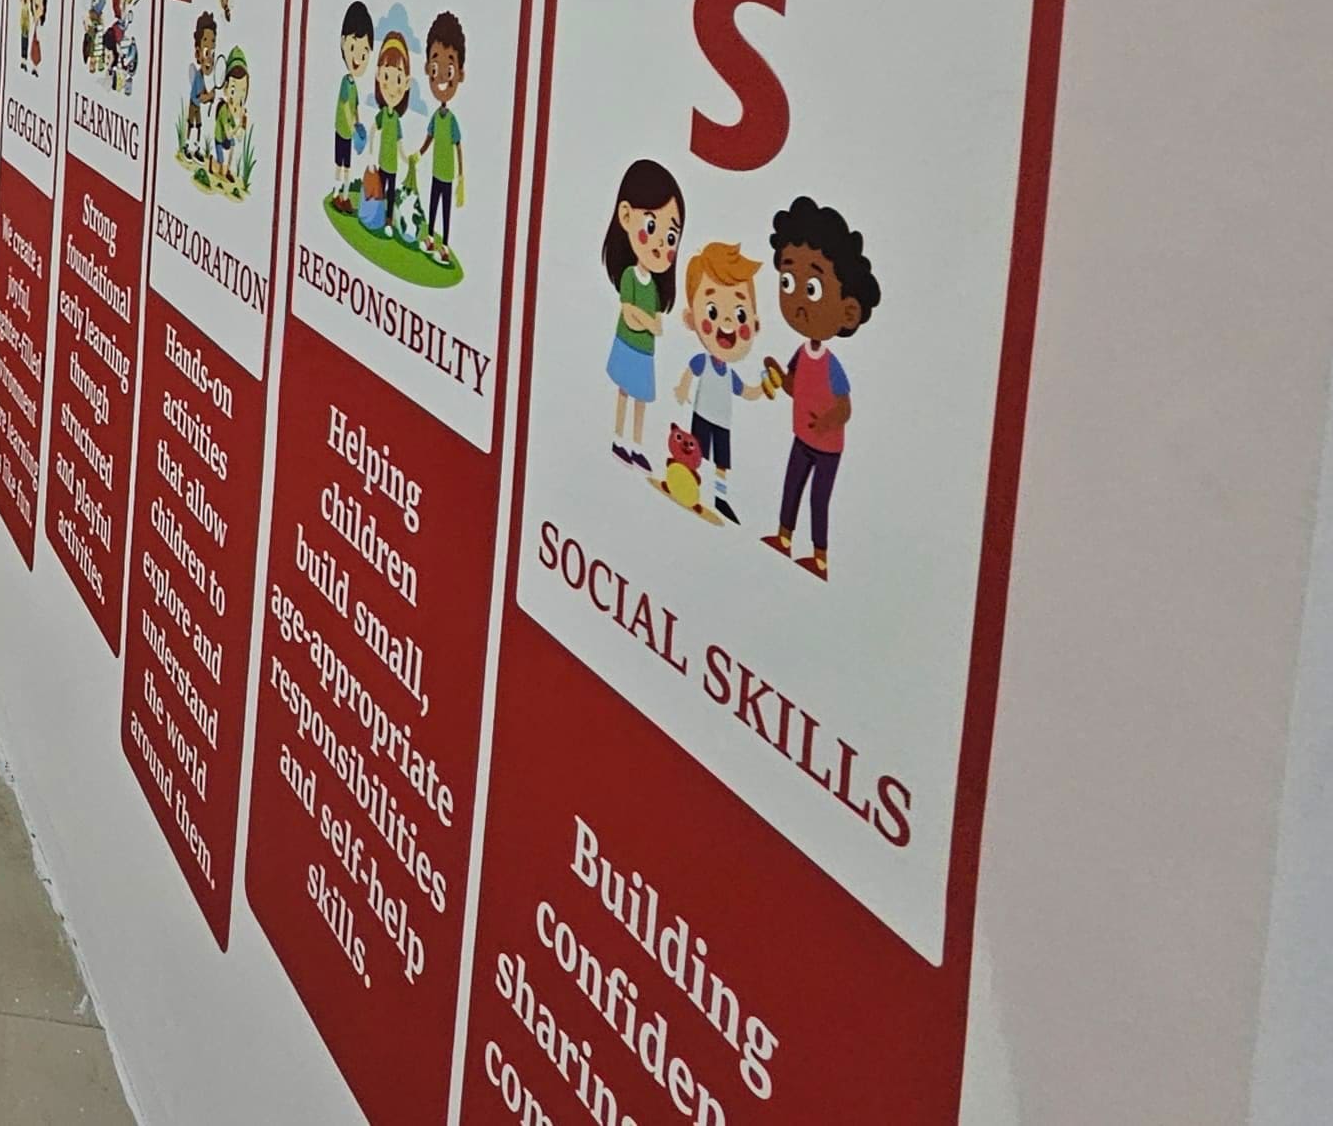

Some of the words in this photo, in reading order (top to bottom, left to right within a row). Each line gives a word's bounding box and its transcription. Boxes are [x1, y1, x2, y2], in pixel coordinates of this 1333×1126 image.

[6, 97, 53, 159] GIGGLES
[74, 92, 139, 161] LEARNING
[13, 232, 36, 272] create
[37, 255, 42, 279] a
[66, 234, 132, 324] foundational
[83, 194, 118, 257] Strong
[156, 205, 269, 316] EXPLORATION
[59, 290, 84, 341] early
[84, 307, 131, 394] learning
[165, 323, 233, 419] Hands-on
[298, 244, 492, 397] RESPONSIBILTY
[70, 351, 109, 425] through
[162, 390, 229, 482] activities
[2, 453, 16, 498] like
[7, 411, 39, 492] learning
[56, 452, 75, 495] and
[75, 478, 112, 553] playful
[61, 403, 113, 491] structured
[158, 439, 184, 498] that
[186, 478, 228, 548] allow
[327, 404, 423, 534] Helping
[57, 510, 105, 605] activities.
[151, 496, 206, 595] children
[209, 570, 227, 617] to
[321, 482, 418, 608] children
[142, 551, 190, 638] explore
[193, 624, 223, 685] and
[295, 523, 349, 618] build
[354, 601, 429, 717] small,
[142, 609, 219, 751] understand
[144, 668, 165, 725] the
[166, 714, 207, 802] world
[271, 584, 454, 827] age-appropriate
[538, 521, 687, 677] SOCIAL
[703, 644, 913, 848] SKILLS
[130, 710, 174, 808] around
[175, 789, 216, 891] them.
[270, 655, 447, 914] responsibilities
[280, 744, 316, 818] and
[320, 804, 425, 985] self-help
[307, 864, 372, 989] skills.
[570, 814, 780, 1101] Building
[495, 952, 639, 1126] sharin
